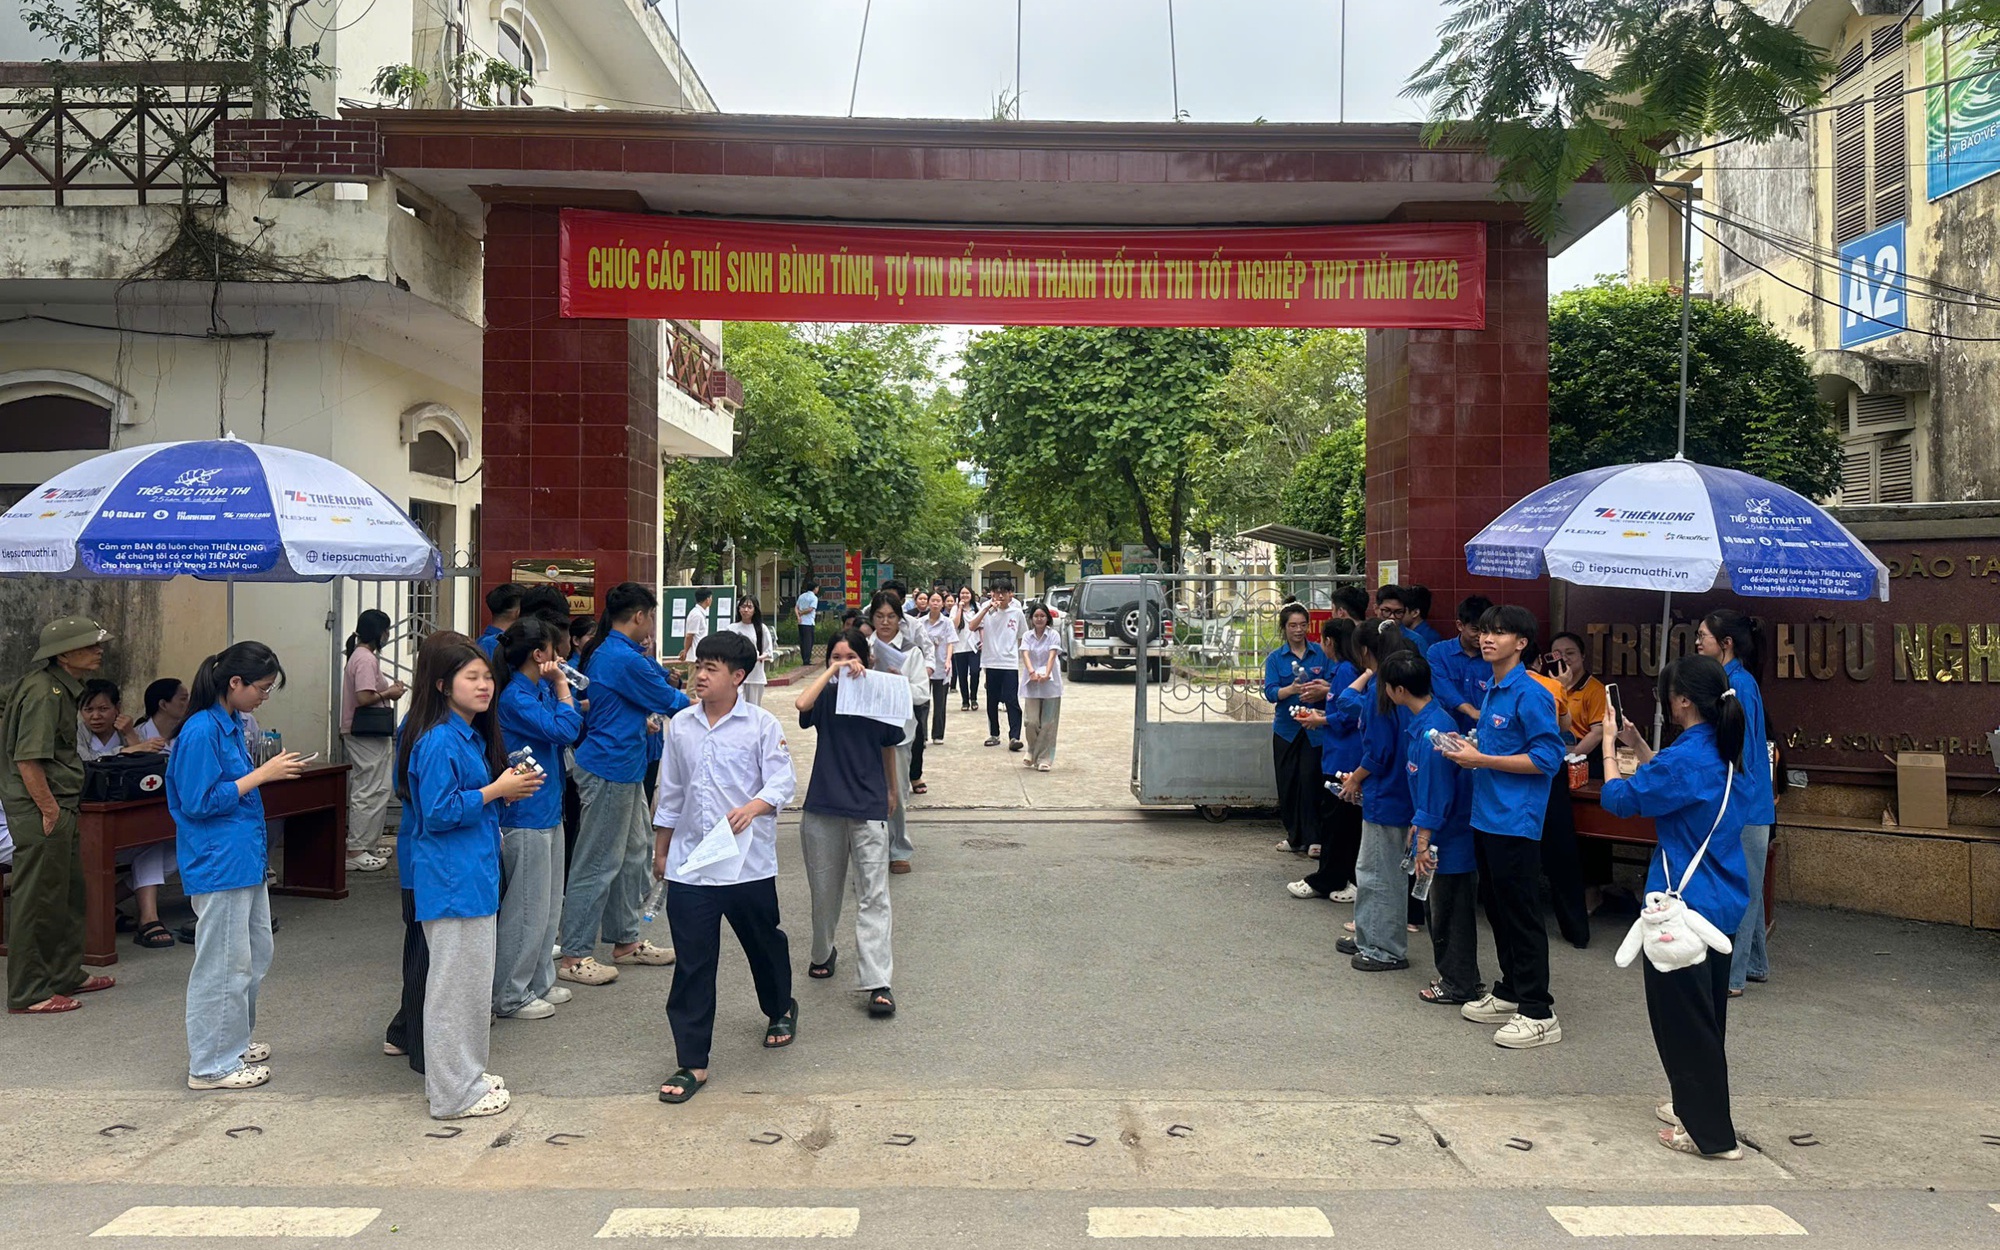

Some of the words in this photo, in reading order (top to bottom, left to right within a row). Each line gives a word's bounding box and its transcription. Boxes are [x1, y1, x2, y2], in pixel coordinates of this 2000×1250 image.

[588, 239, 640, 290] CHÚC
[646, 240, 685, 291] CÁC
[691, 242, 721, 292] THÍ
[726, 250, 773, 293] SINH
[779, 244, 825, 294] BÌNH
[830, 246, 879, 301] TĨNH,
[885, 251, 910, 305] TỰ
[914, 256, 943, 298] TIN
[948, 240, 974, 298] ĐỂ
[979, 251, 1030, 298] HOÀN
[1035, 250, 1097, 299] THÀNH
[1102, 245, 1135, 299] TỐT
[1140, 251, 1159, 299] KÌ
[1164, 260, 1194, 299] THI
[1199, 245, 1232, 300] TỐT
[1237, 251, 1307, 308] NGHIỆP
[1312, 260, 1358, 300] THPT
[1363, 251, 1408, 300] NĂM
[1413, 260, 1459, 301] 2026
[1846, 245, 1898, 328] A2
[136, 484, 163, 496] TIẾP
[164, 485, 193, 496] SỨC
[230, 487, 251, 495] THI
[102, 510, 115, 519] BỘ
[1620, 509, 1696, 522] THIÊNLONG
[1729, 513, 1748, 523] TIẾP
[1750, 514, 1770, 524] SỨC
[1798, 517, 1812, 525] THI
[134, 543, 154, 553] BẠN
[188, 543, 210, 553] chọn
[211, 542, 238, 551] THIÊN
[239, 543, 264, 552] LONG
[128, 552, 154, 561] chúng
[208, 551, 228, 561] TIẾP
[229, 552, 247, 561] SỨC
[321, 552, 408, 564] tiepsucmuathi.vn
[101, 561, 118, 570] cho
[119, 562, 142, 571] hàng
[184, 561, 206, 571] trong
[219, 561, 240, 569] NĂM
[1886, 550, 1955, 579] ĐÀO
[1588, 563, 1689, 579] tiepsucmuathi.vn
[1764, 567, 1778, 576] BẠN
[1821, 569, 1840, 578] THIÊN
[1819, 577, 1834, 586] TIẾP
[1835, 578, 1850, 586] SỨC
[1827, 587, 1845, 595] NĂM
[1587, 609, 1700, 677] TRƯỜ
[1776, 609, 1875, 681] HỮU
[1841, 731, 1884, 752] SƠN
